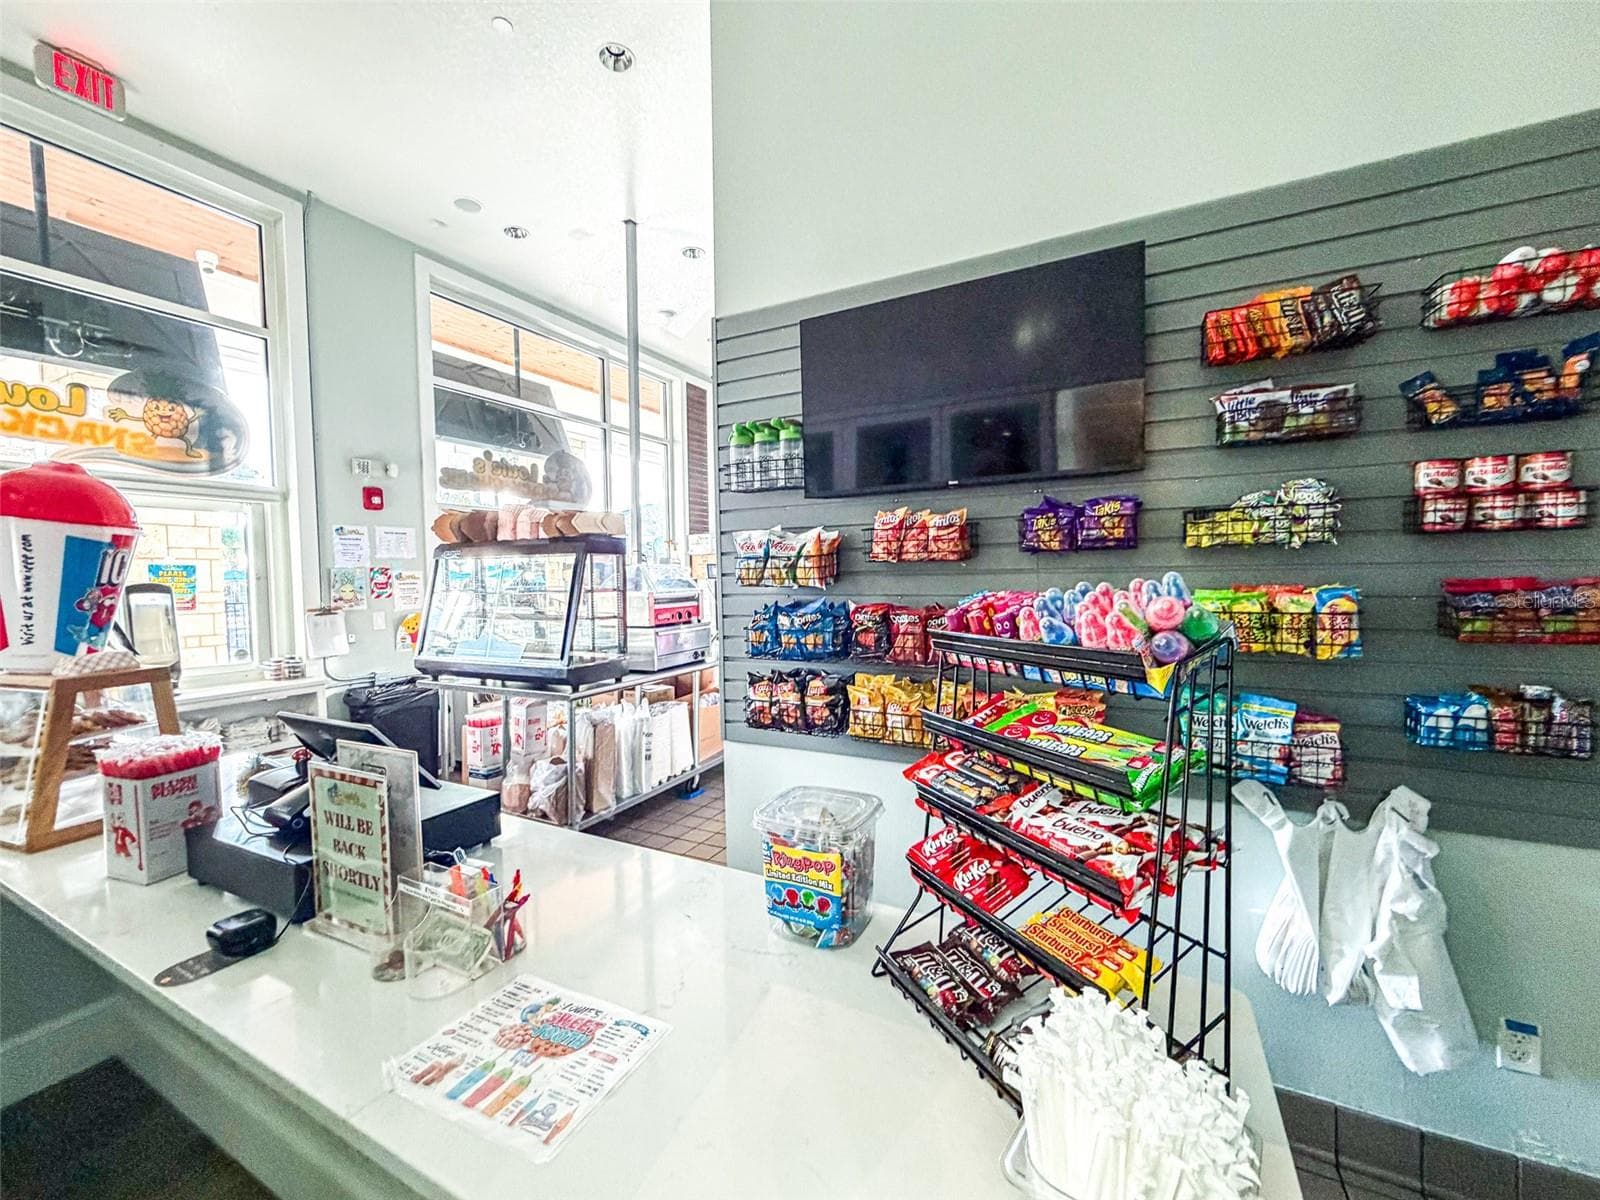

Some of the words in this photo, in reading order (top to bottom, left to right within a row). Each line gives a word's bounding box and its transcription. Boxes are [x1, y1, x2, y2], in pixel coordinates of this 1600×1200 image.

[53, 50, 114, 111] EXIT
[1093, 501, 1121, 516] Takis
[1032, 517, 1057, 531] Takis
[23, 611, 34, 622] us
[890, 614, 920, 624] Doritos
[927, 616, 947, 627] Dori
[20, 624, 34, 645] Visit
[1039, 723, 1115, 743] AIRHEADS
[1192, 715, 1236, 729] Wech
[1244, 717, 1290, 731] Welch's
[1018, 737, 1088, 757] RHEADS
[1019, 781, 1053, 808] bueno
[323, 809, 355, 832] WILL
[357, 817, 374, 837] BE
[1051, 816, 1105, 841] bueno
[332, 838, 367, 861] BACK
[321, 860, 381, 892] SHORTLY
[766, 868, 791, 880] Limited
[791, 872, 818, 887] Edition
[818, 879, 834, 891] Mix
[1048, 916, 1104, 953] Starburst
[1061, 907, 1116, 943] Starburst
[1029, 924, 1080, 961] Starburst
